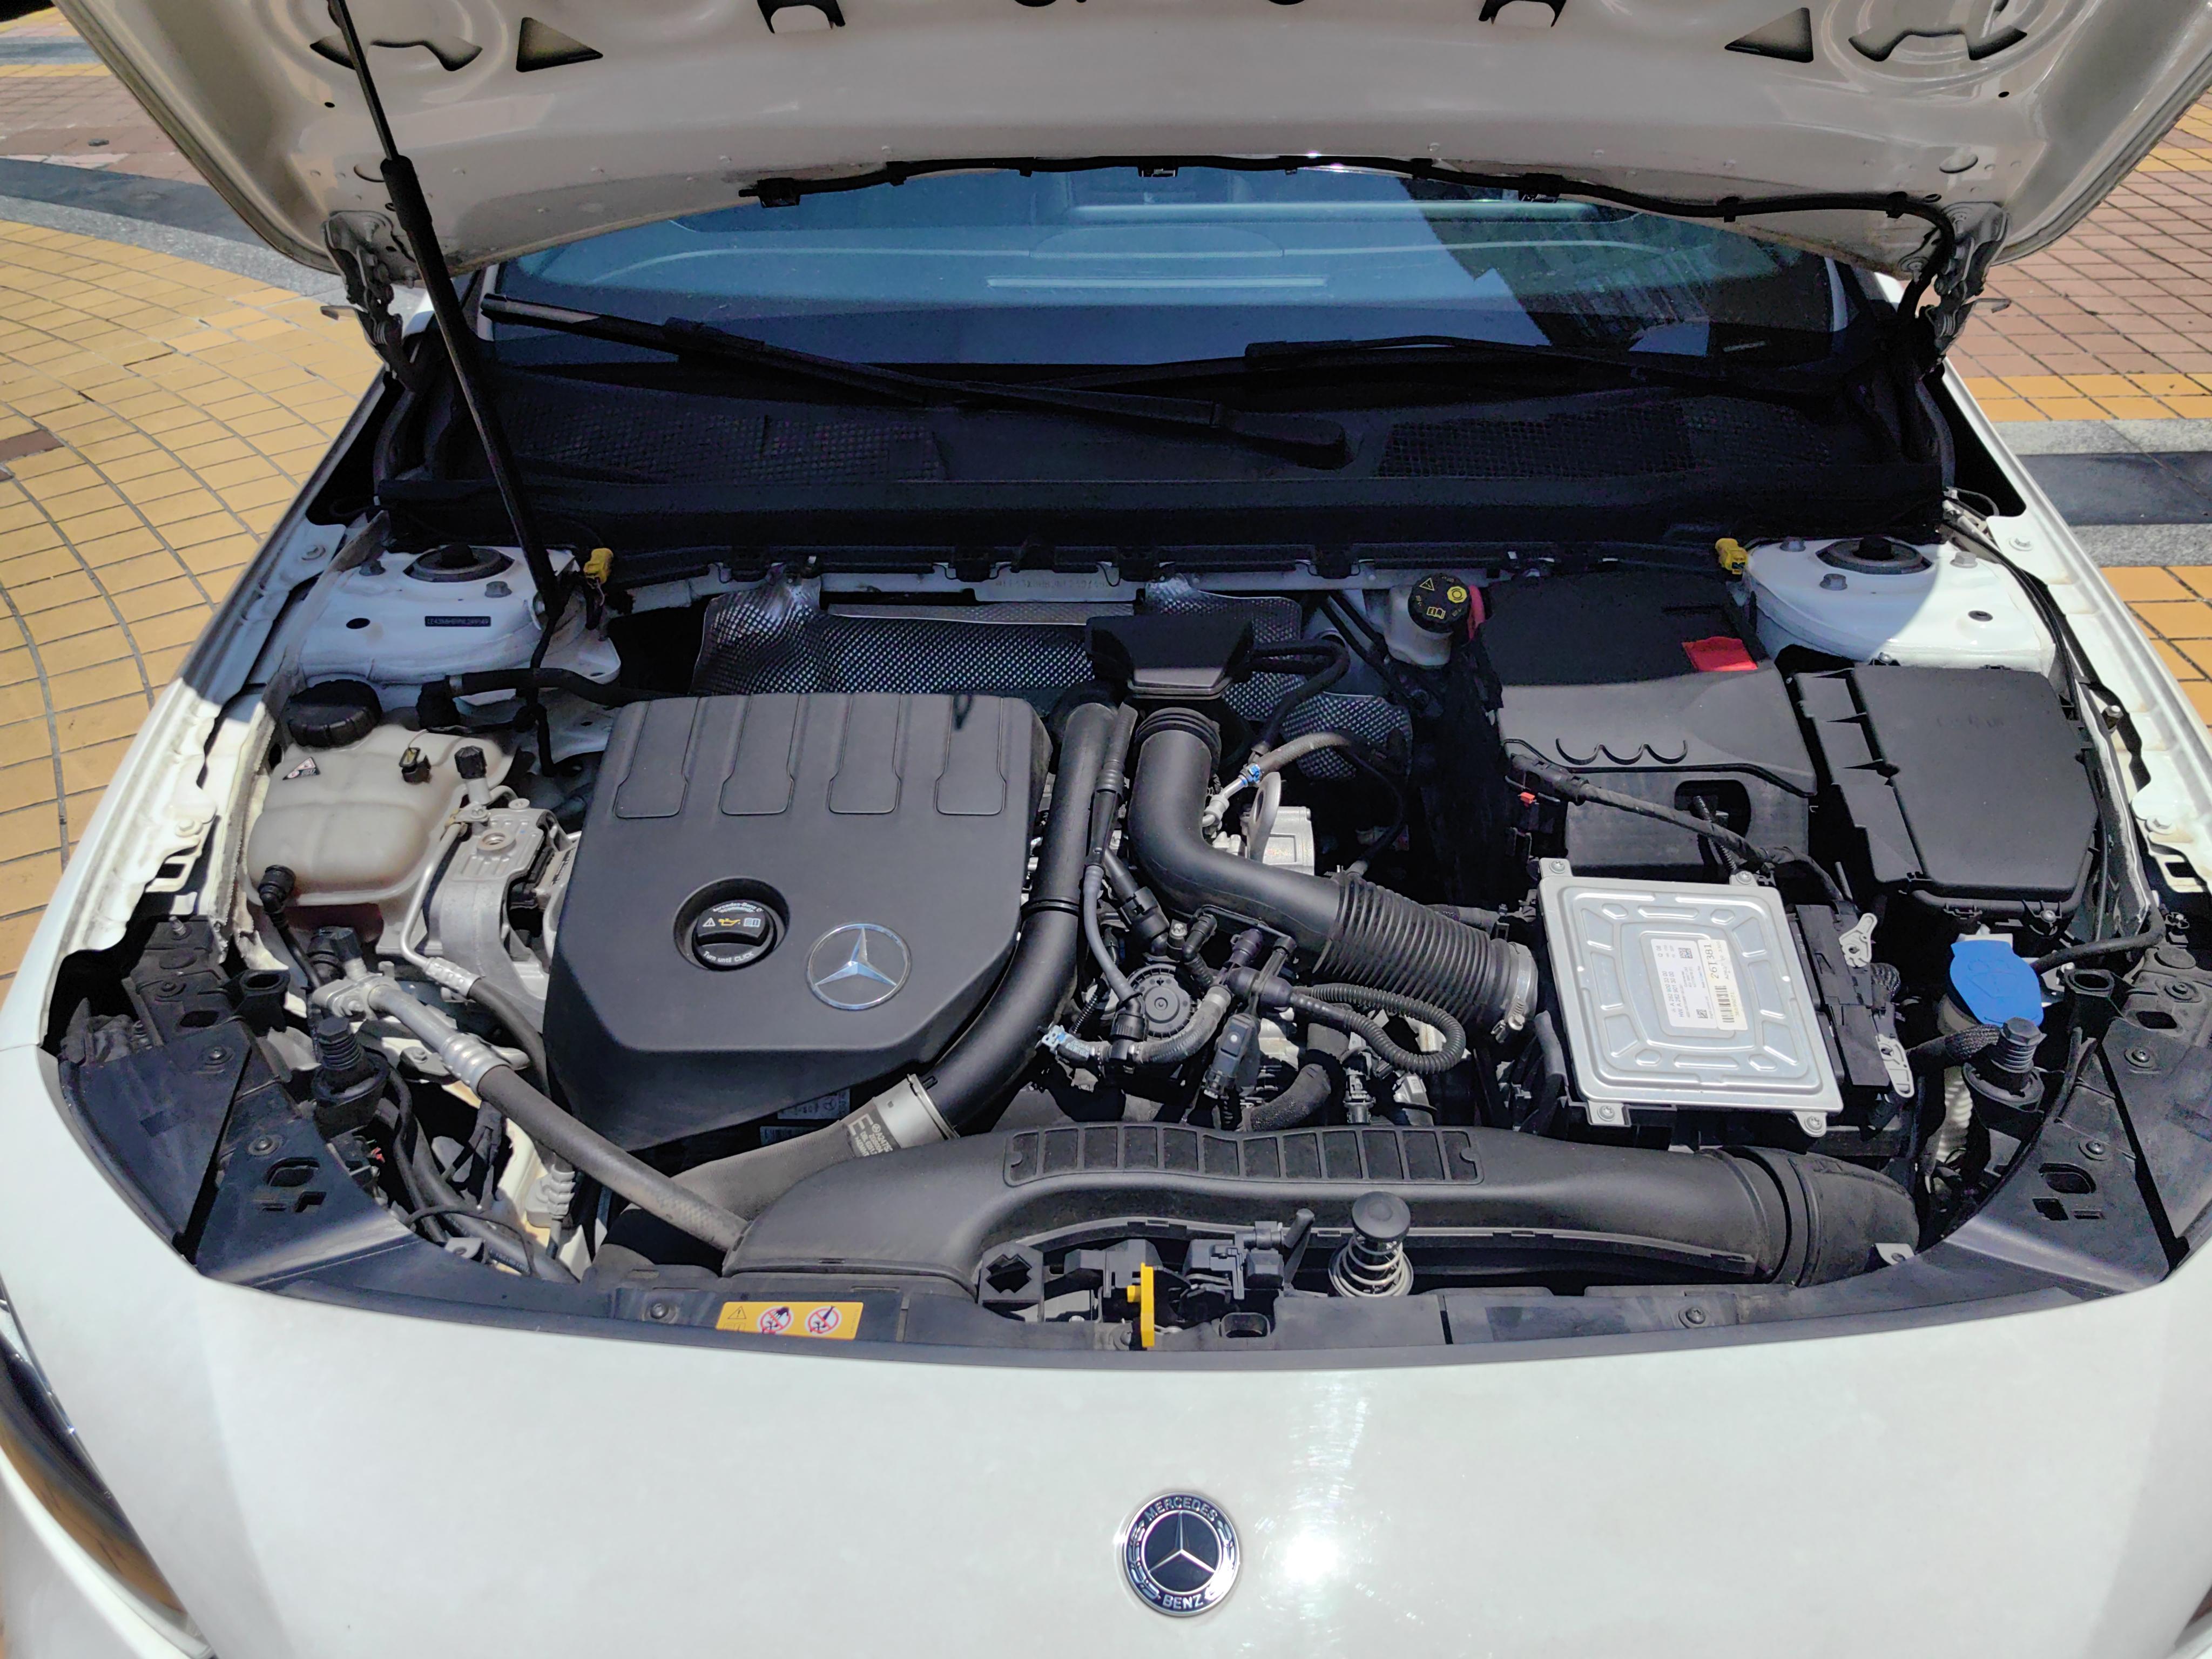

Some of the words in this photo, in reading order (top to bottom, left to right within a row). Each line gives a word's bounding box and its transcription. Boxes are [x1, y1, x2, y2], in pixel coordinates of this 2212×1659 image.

[703, 950, 716, 961] Turn
[734, 951, 754, 961] CLICK
[1144, 1496, 1218, 1522] MERCEDES
[1162, 1594, 1204, 1609] BENZ
